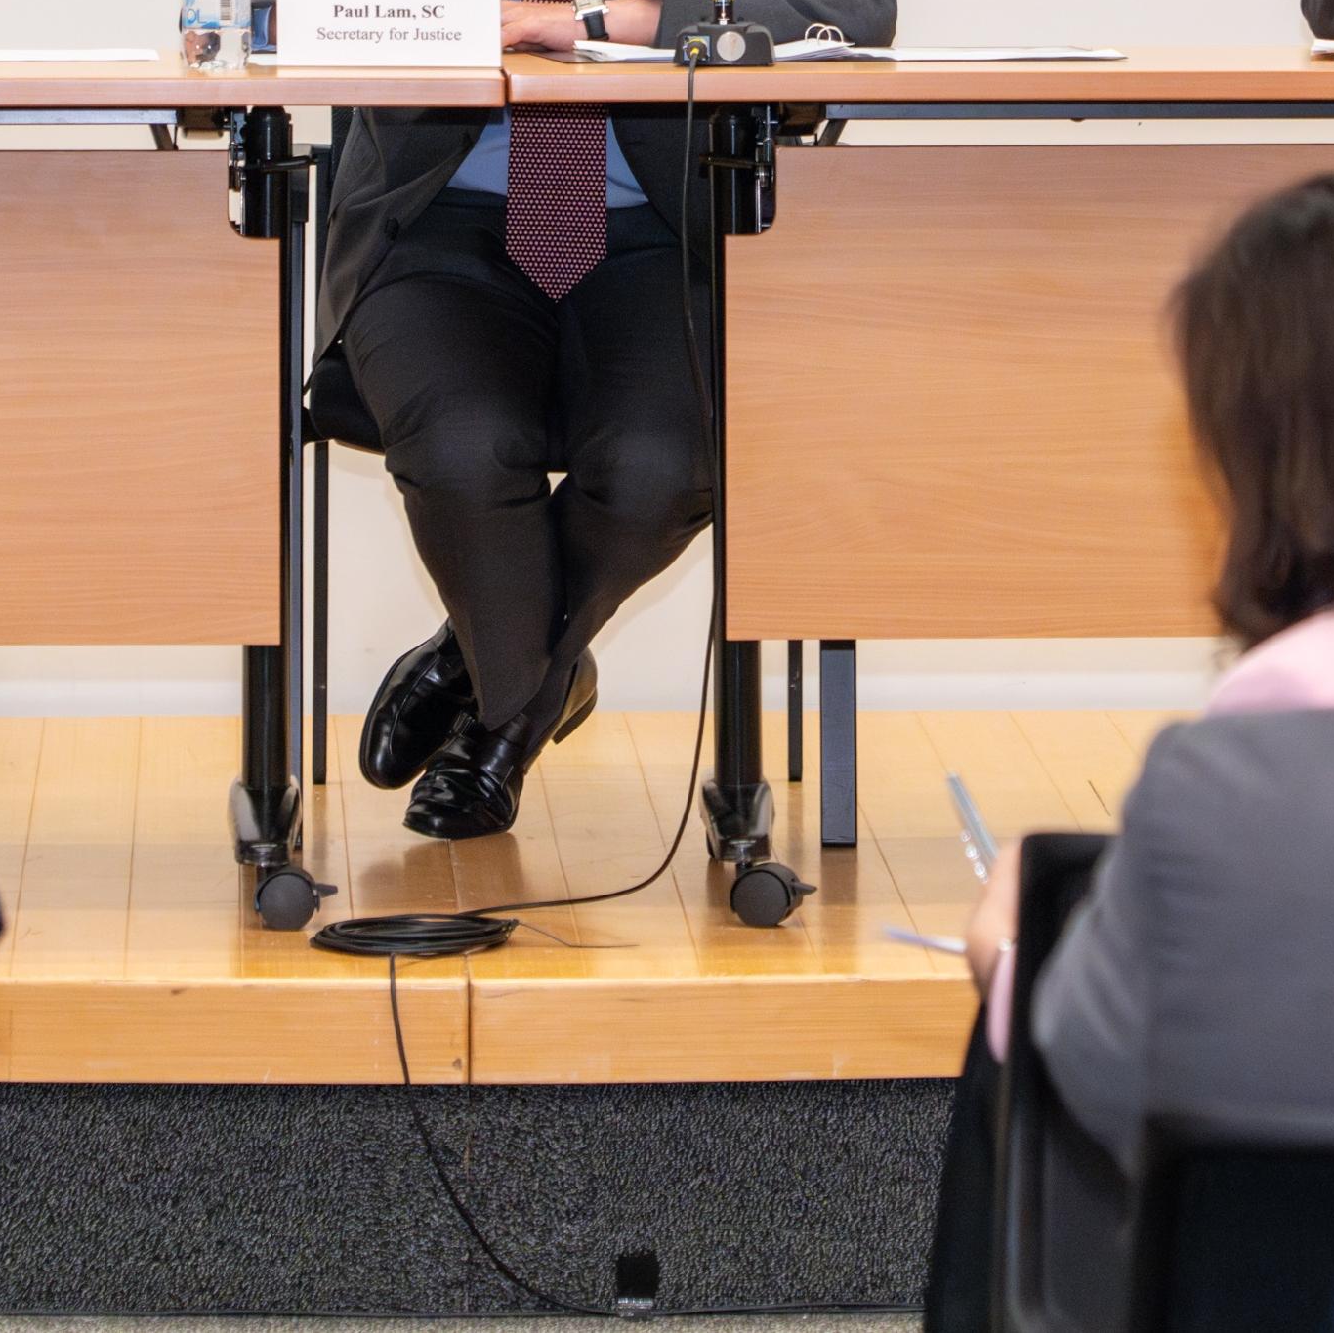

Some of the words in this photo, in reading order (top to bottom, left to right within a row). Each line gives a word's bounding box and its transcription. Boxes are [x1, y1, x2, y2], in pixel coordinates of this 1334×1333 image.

[333, 4, 369, 18] Paul
[375, 5, 417, 19] Lam,
[421, 5, 445, 18] SC
[316, 27, 384, 43] Secretary
[389, 27, 409, 40] for
[413, 27, 462, 41] Justice
